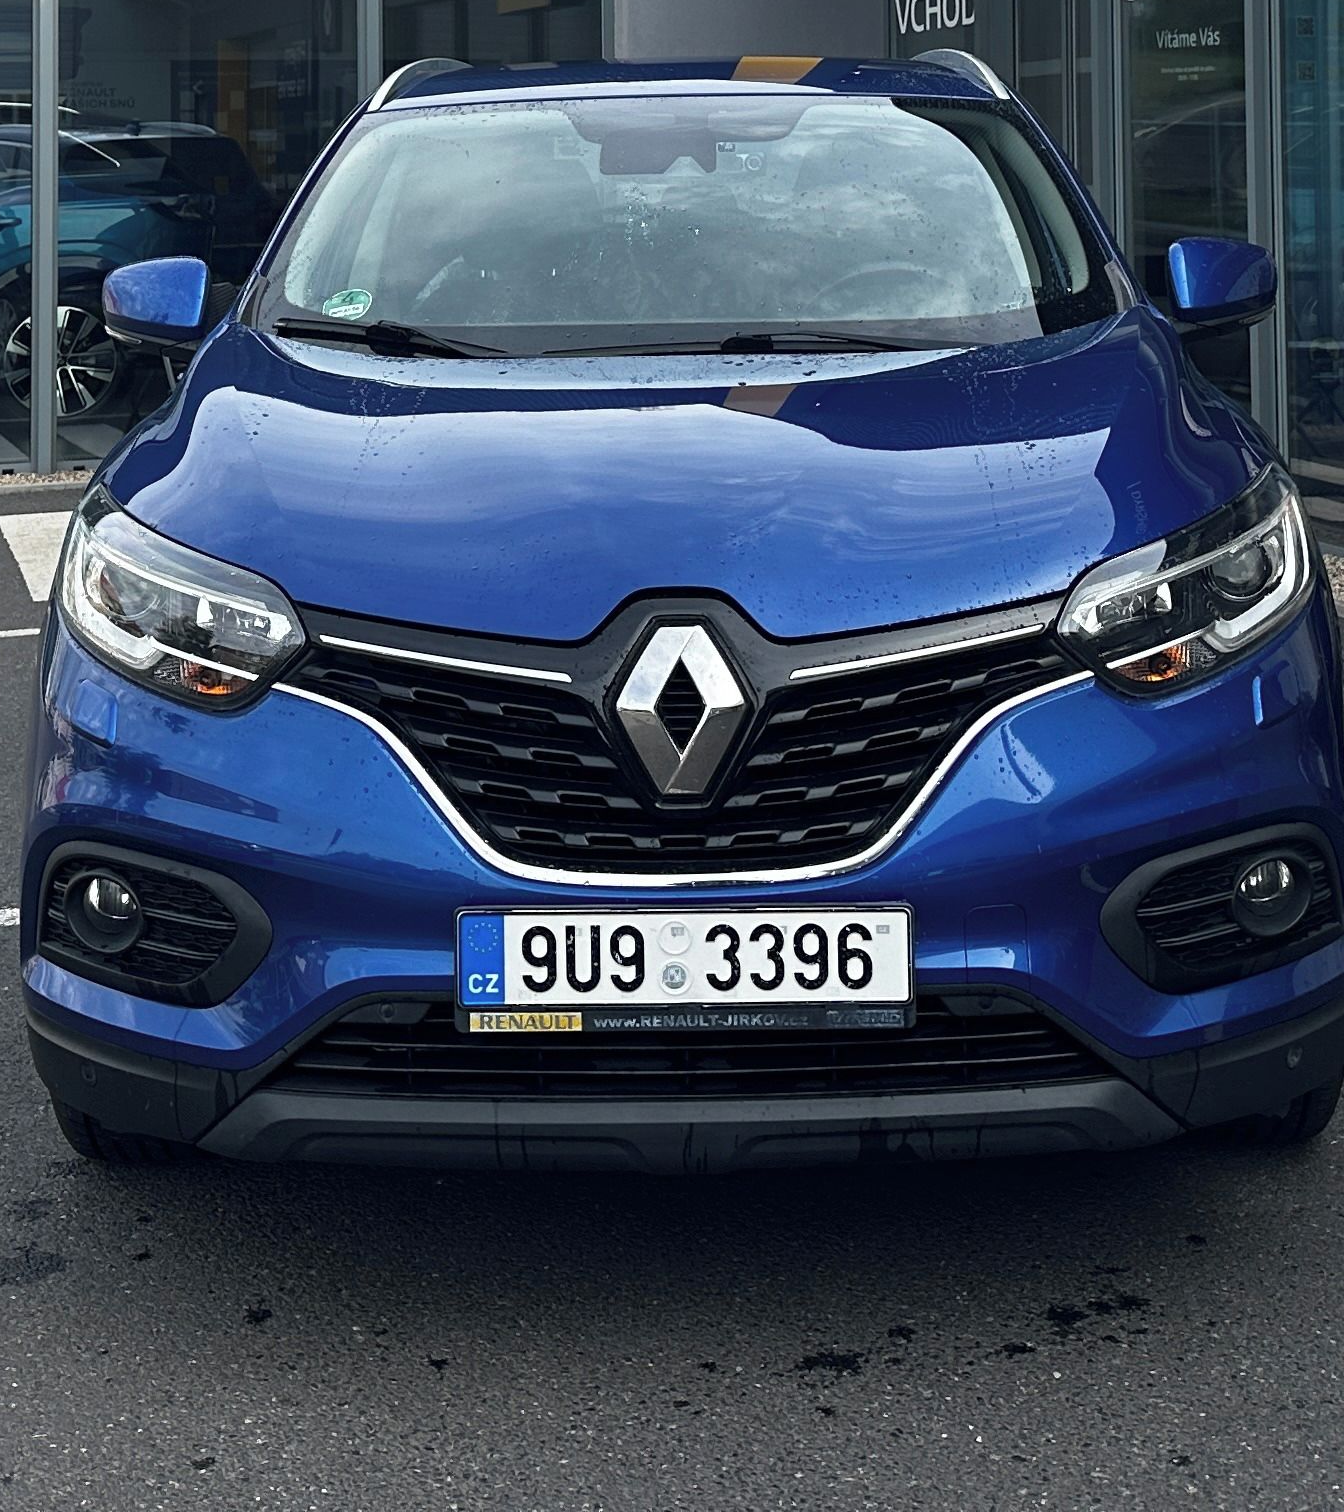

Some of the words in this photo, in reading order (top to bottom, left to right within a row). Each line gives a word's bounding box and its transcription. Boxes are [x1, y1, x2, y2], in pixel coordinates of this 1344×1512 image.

[1155, 28, 1197, 49] Vítáme
[1199, 25, 1220, 46] Vás
[521, 924, 646, 993] 9U9
[705, 923, 874, 991] 3396
[468, 973, 500, 994] CZ
[479, 1014, 577, 1030] RENAULT
